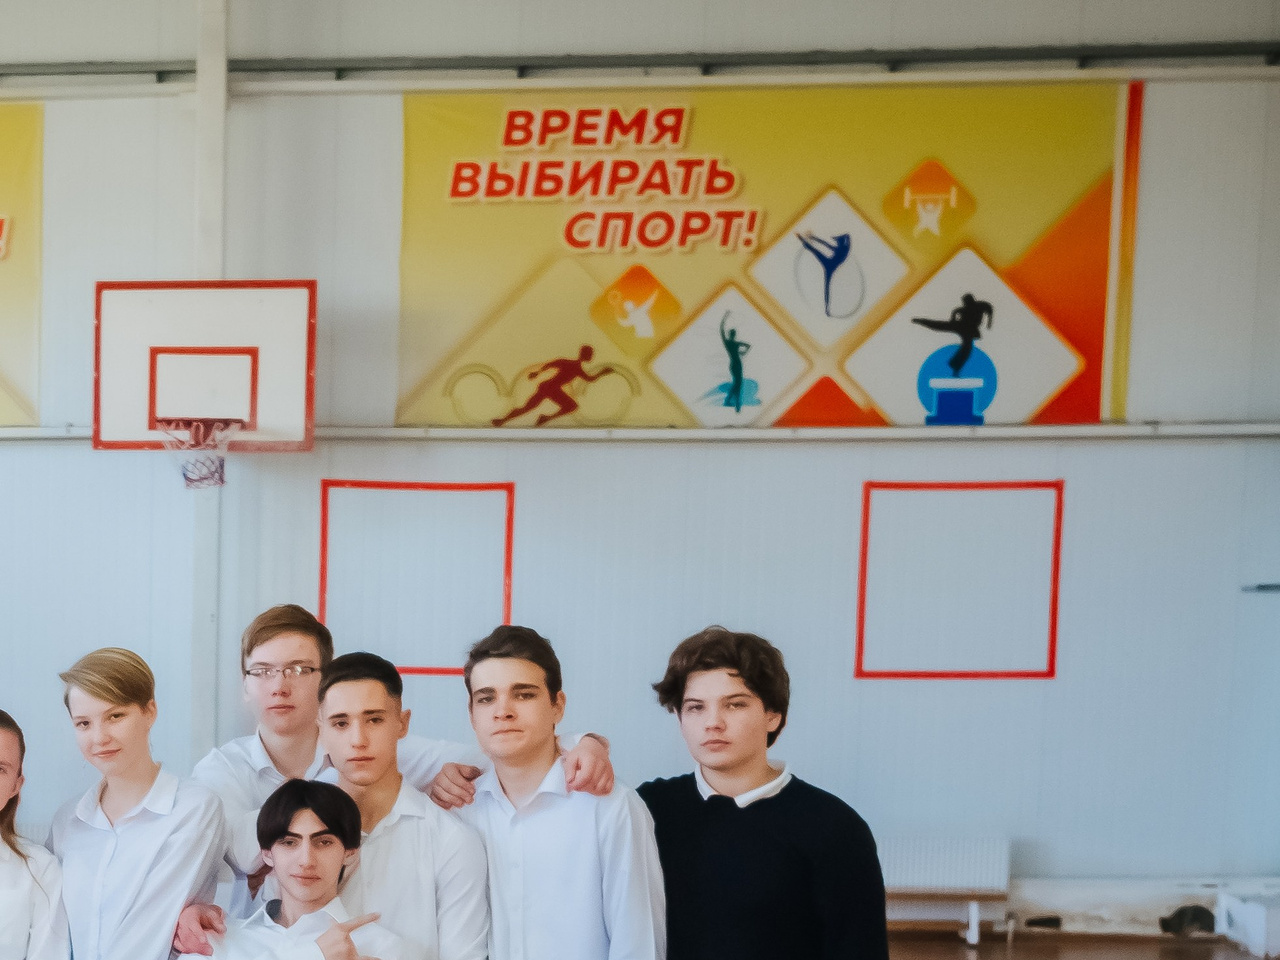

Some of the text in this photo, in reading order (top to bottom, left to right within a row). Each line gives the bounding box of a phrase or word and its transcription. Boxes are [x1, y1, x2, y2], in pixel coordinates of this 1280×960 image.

[502, 107, 686, 147] ВРЕМЯ
[450, 159, 737, 199] ВЫБИРАТЬ
[563, 210, 760, 249] СПОРТ!
